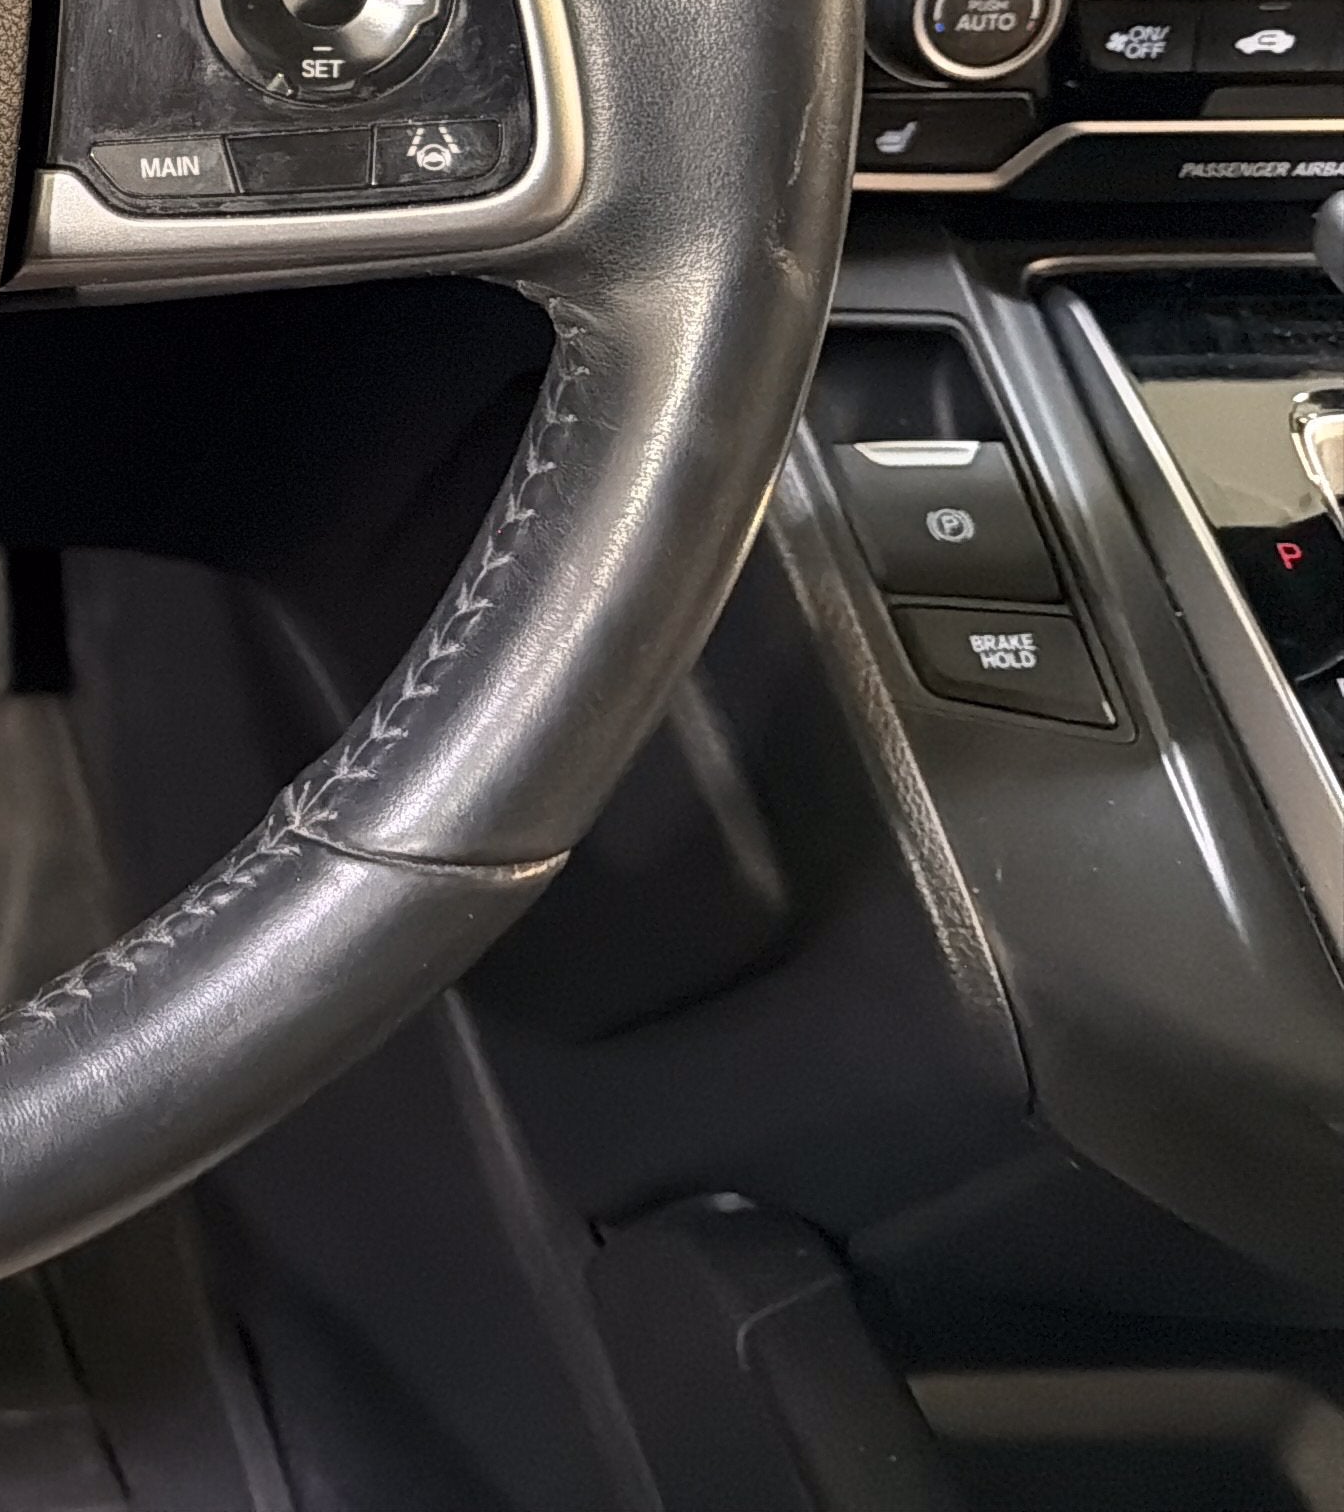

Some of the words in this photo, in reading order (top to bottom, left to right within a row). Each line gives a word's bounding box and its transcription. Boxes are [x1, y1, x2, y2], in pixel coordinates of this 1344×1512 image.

[967, 0, 1009, 12] PUSH
[955, 13, 1016, 31] AUTO
[1125, 41, 1166, 59] OFF
[301, 59, 344, 79] SET
[140, 155, 201, 178] MAIN
[1178, 161, 1291, 179] PASSENGER
[1276, 542, 1303, 570] P
[969, 633, 1037, 652] BRAKE
[980, 650, 1037, 669] HOLD
